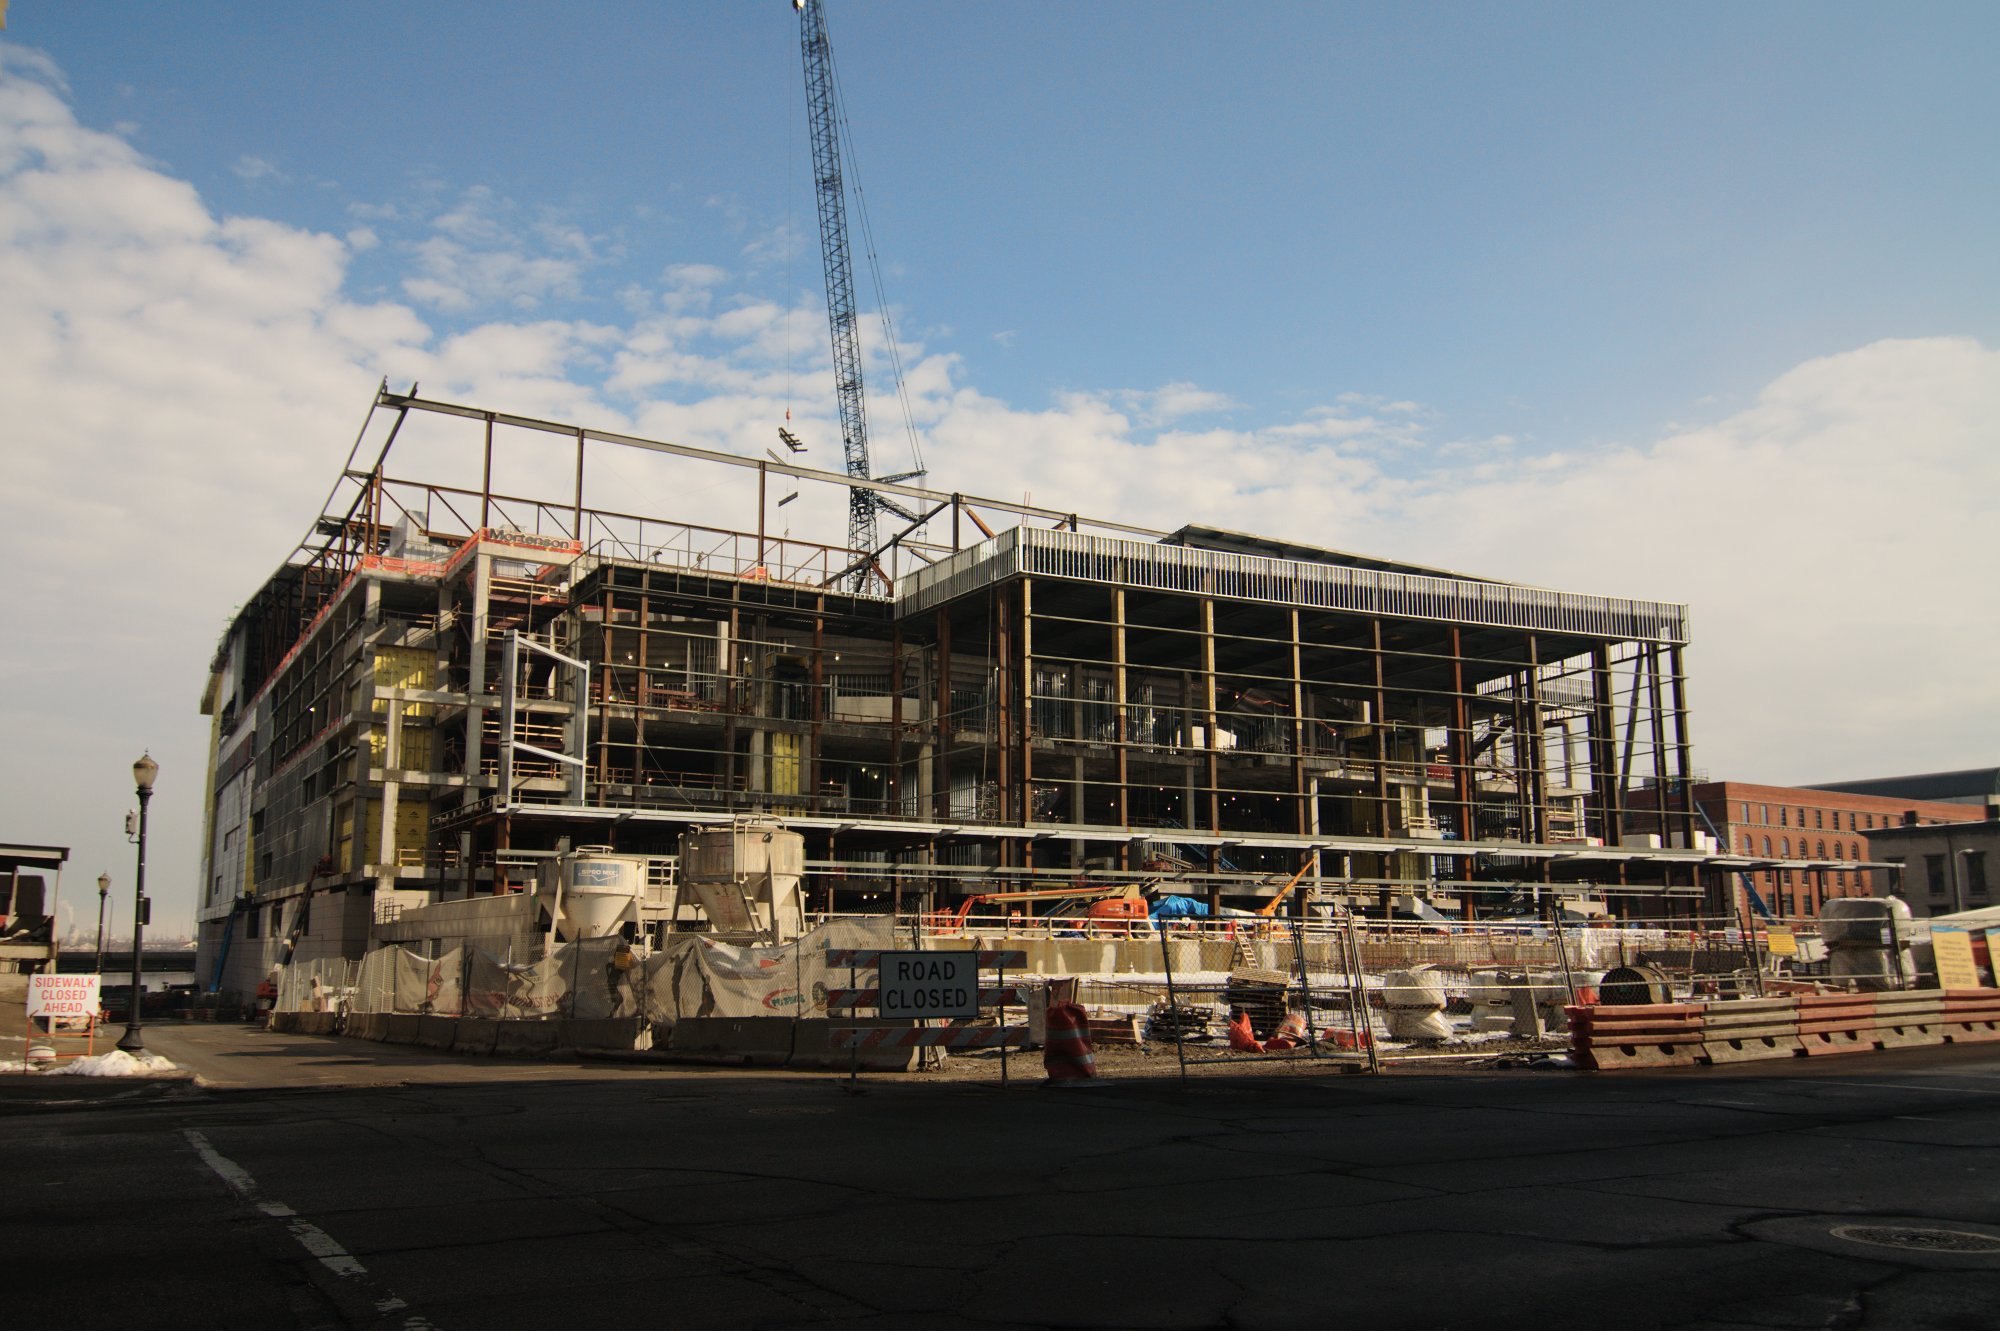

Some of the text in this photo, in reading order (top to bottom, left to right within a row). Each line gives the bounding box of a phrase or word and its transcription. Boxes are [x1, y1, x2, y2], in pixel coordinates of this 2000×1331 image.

[489, 528, 569, 549] Mortenson
[898, 961, 956, 981] ROAD
[35, 977, 95, 988] SIDEWALK
[41, 990, 87, 1000] CLOSED
[886, 988, 967, 1010] CLOSED
[44, 1002, 82, 1013] AHEAD
